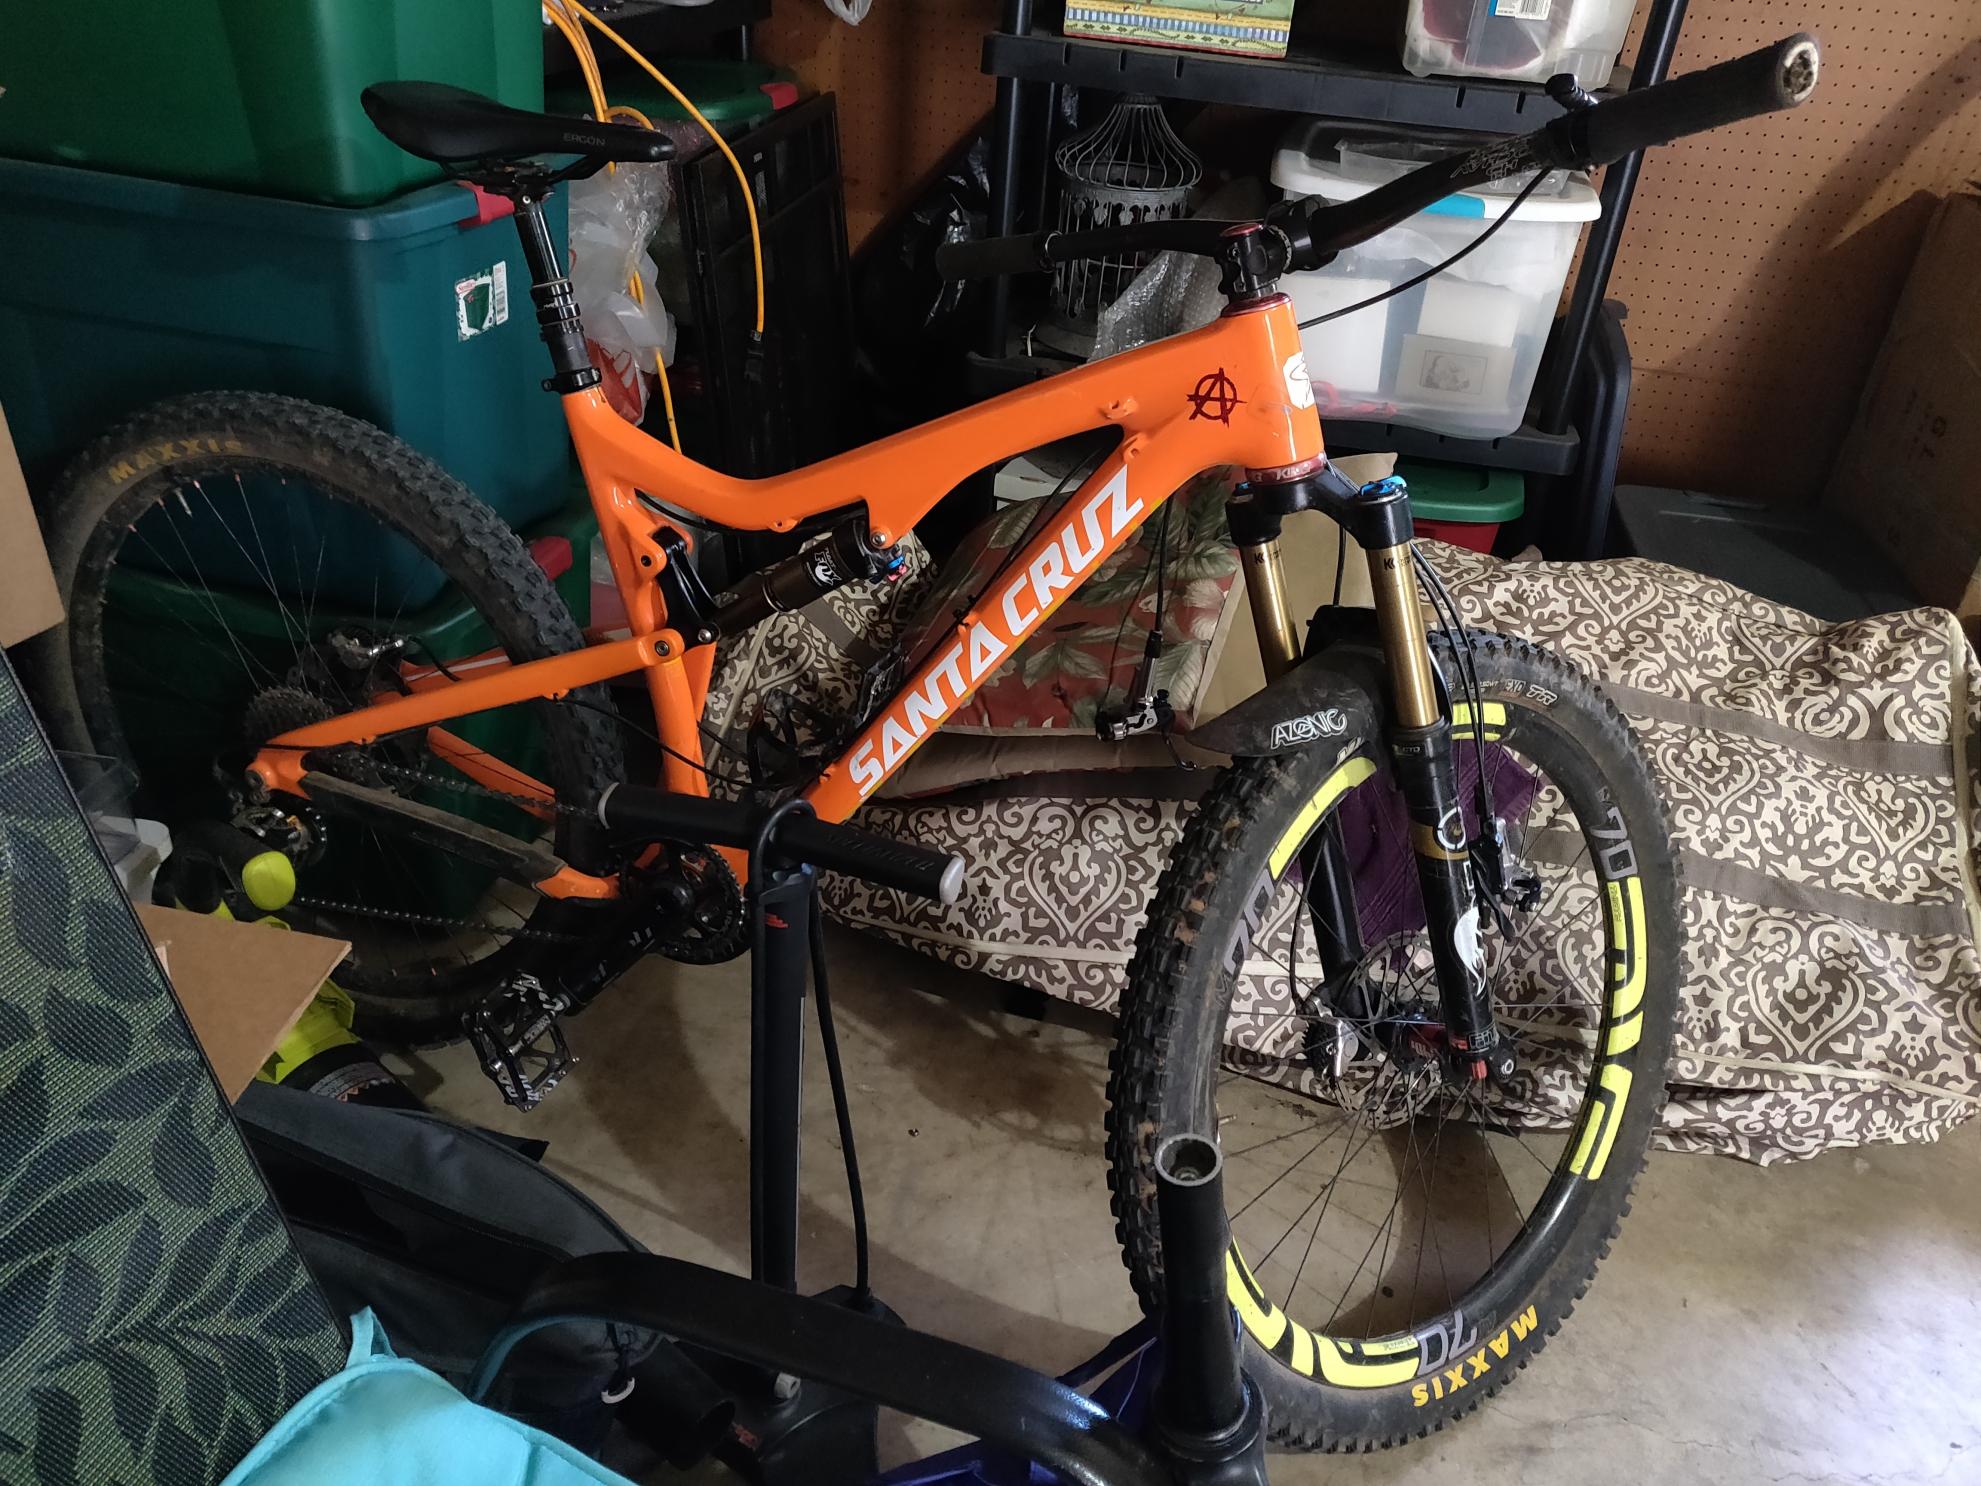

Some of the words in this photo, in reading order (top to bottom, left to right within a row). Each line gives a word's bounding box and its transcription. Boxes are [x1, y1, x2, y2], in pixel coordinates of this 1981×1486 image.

[563, 132, 606, 146] ERGON
[108, 438, 242, 484] MAXXIS
[849, 621, 1009, 797] SANTA
[1002, 463, 1145, 637] CRUZ
[1270, 708, 1348, 750] AZONIC
[1411, 1304, 1539, 1407] MAXXIS
